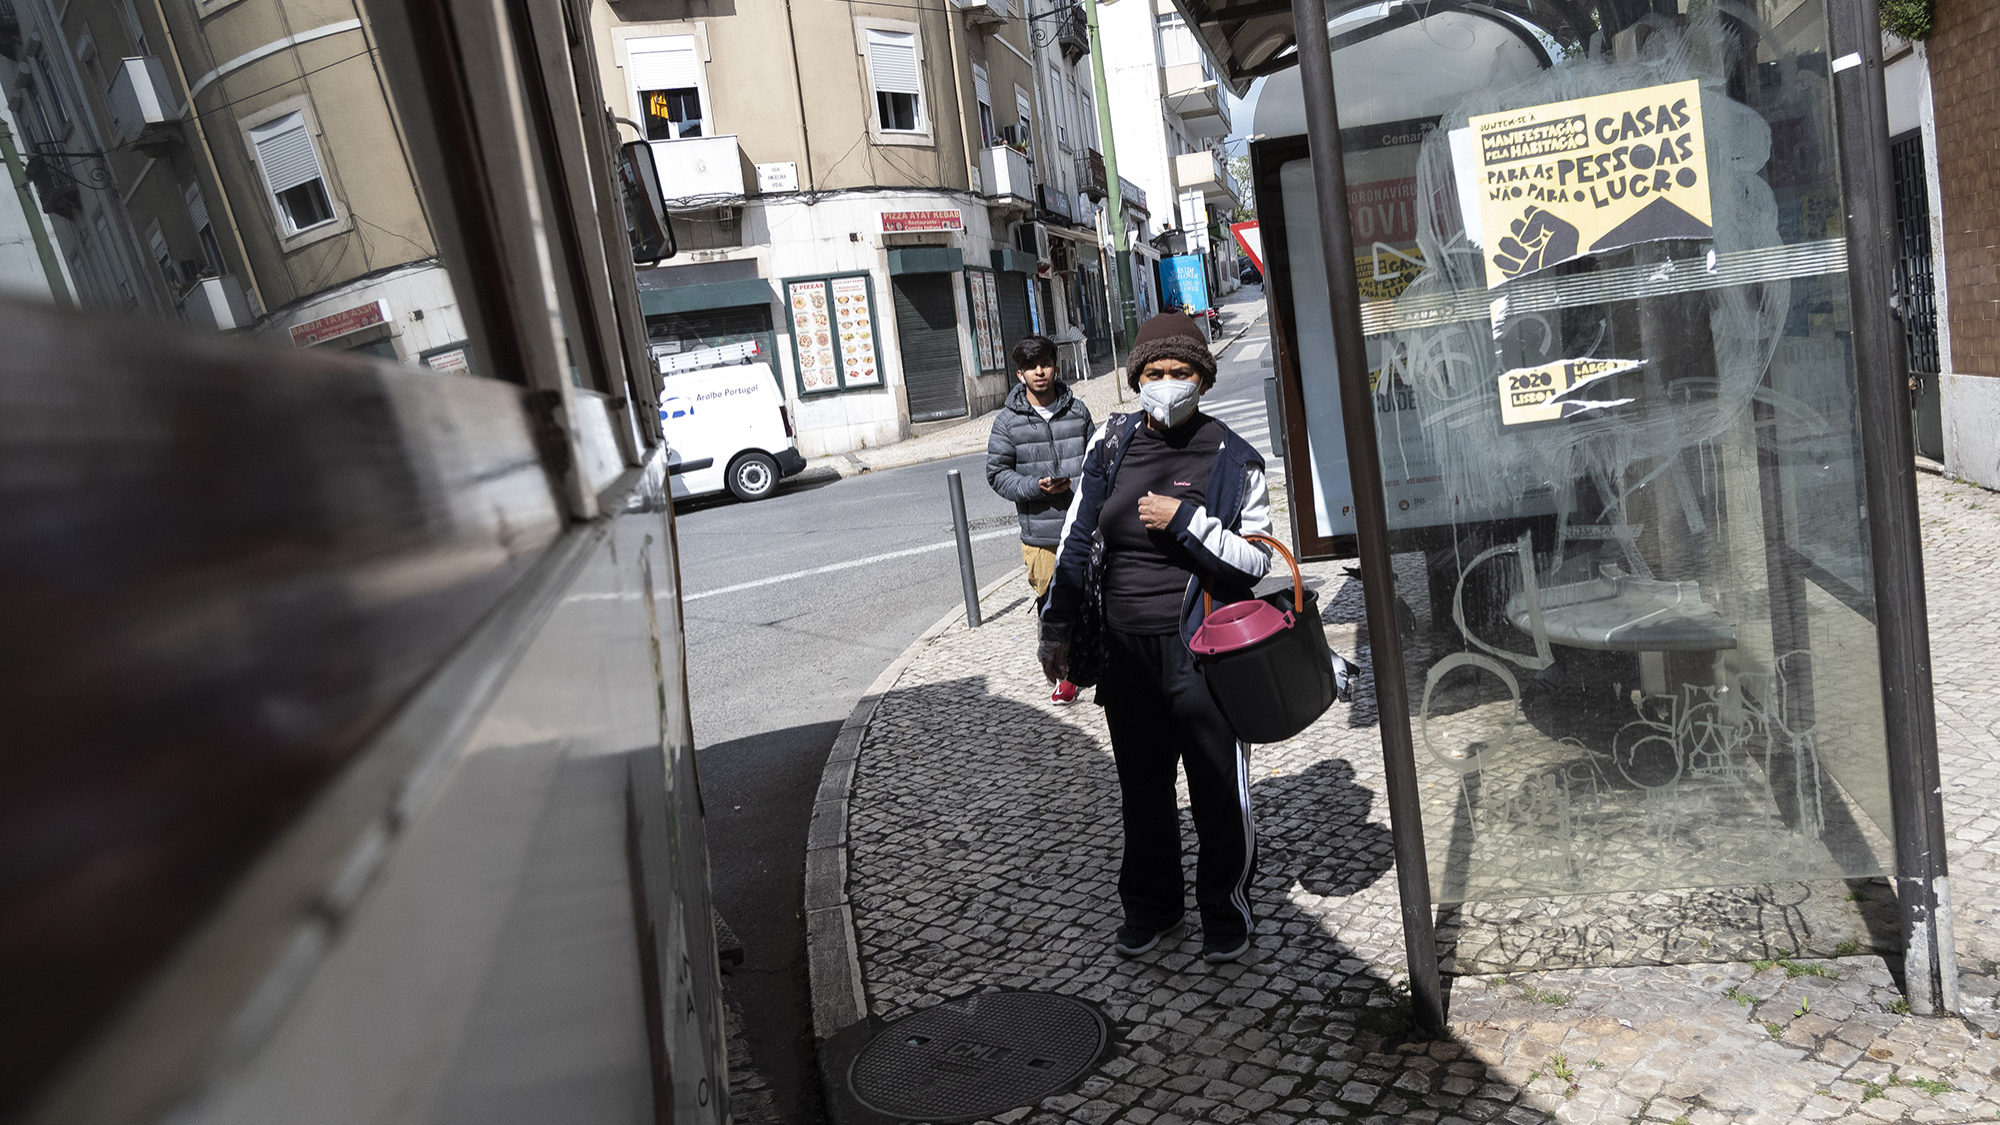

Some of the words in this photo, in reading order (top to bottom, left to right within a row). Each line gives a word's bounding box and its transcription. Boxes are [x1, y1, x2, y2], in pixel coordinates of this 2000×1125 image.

[1595, 97, 1690, 145] CASAS
[1484, 118, 1585, 149] MANIFESTAÇÃO
[1486, 148, 1509, 161] PELA
[1510, 133, 1587, 158] HABITAÇÃO
[1487, 166, 1529, 184] PARA
[1533, 164, 1553, 180] AS
[1557, 132, 1693, 186] PESSOAS
[1489, 185, 1522, 201] NÃO
[1527, 183, 1568, 203] PARA
[1573, 190, 1585, 203] O
[1589, 167, 1697, 209] LUCRO
[883, 211, 908, 220] PIZZA
[910, 211, 930, 219] AYAT
[933, 210, 960, 218] KEBAB
[799, 283, 824, 291] PIZZAS
[1574, 361, 1615, 375] LARGO
[1509, 372, 1552, 390] 2020
[724, 384, 759, 397] Portugal
[1512, 390, 1553, 406] LISBOA
